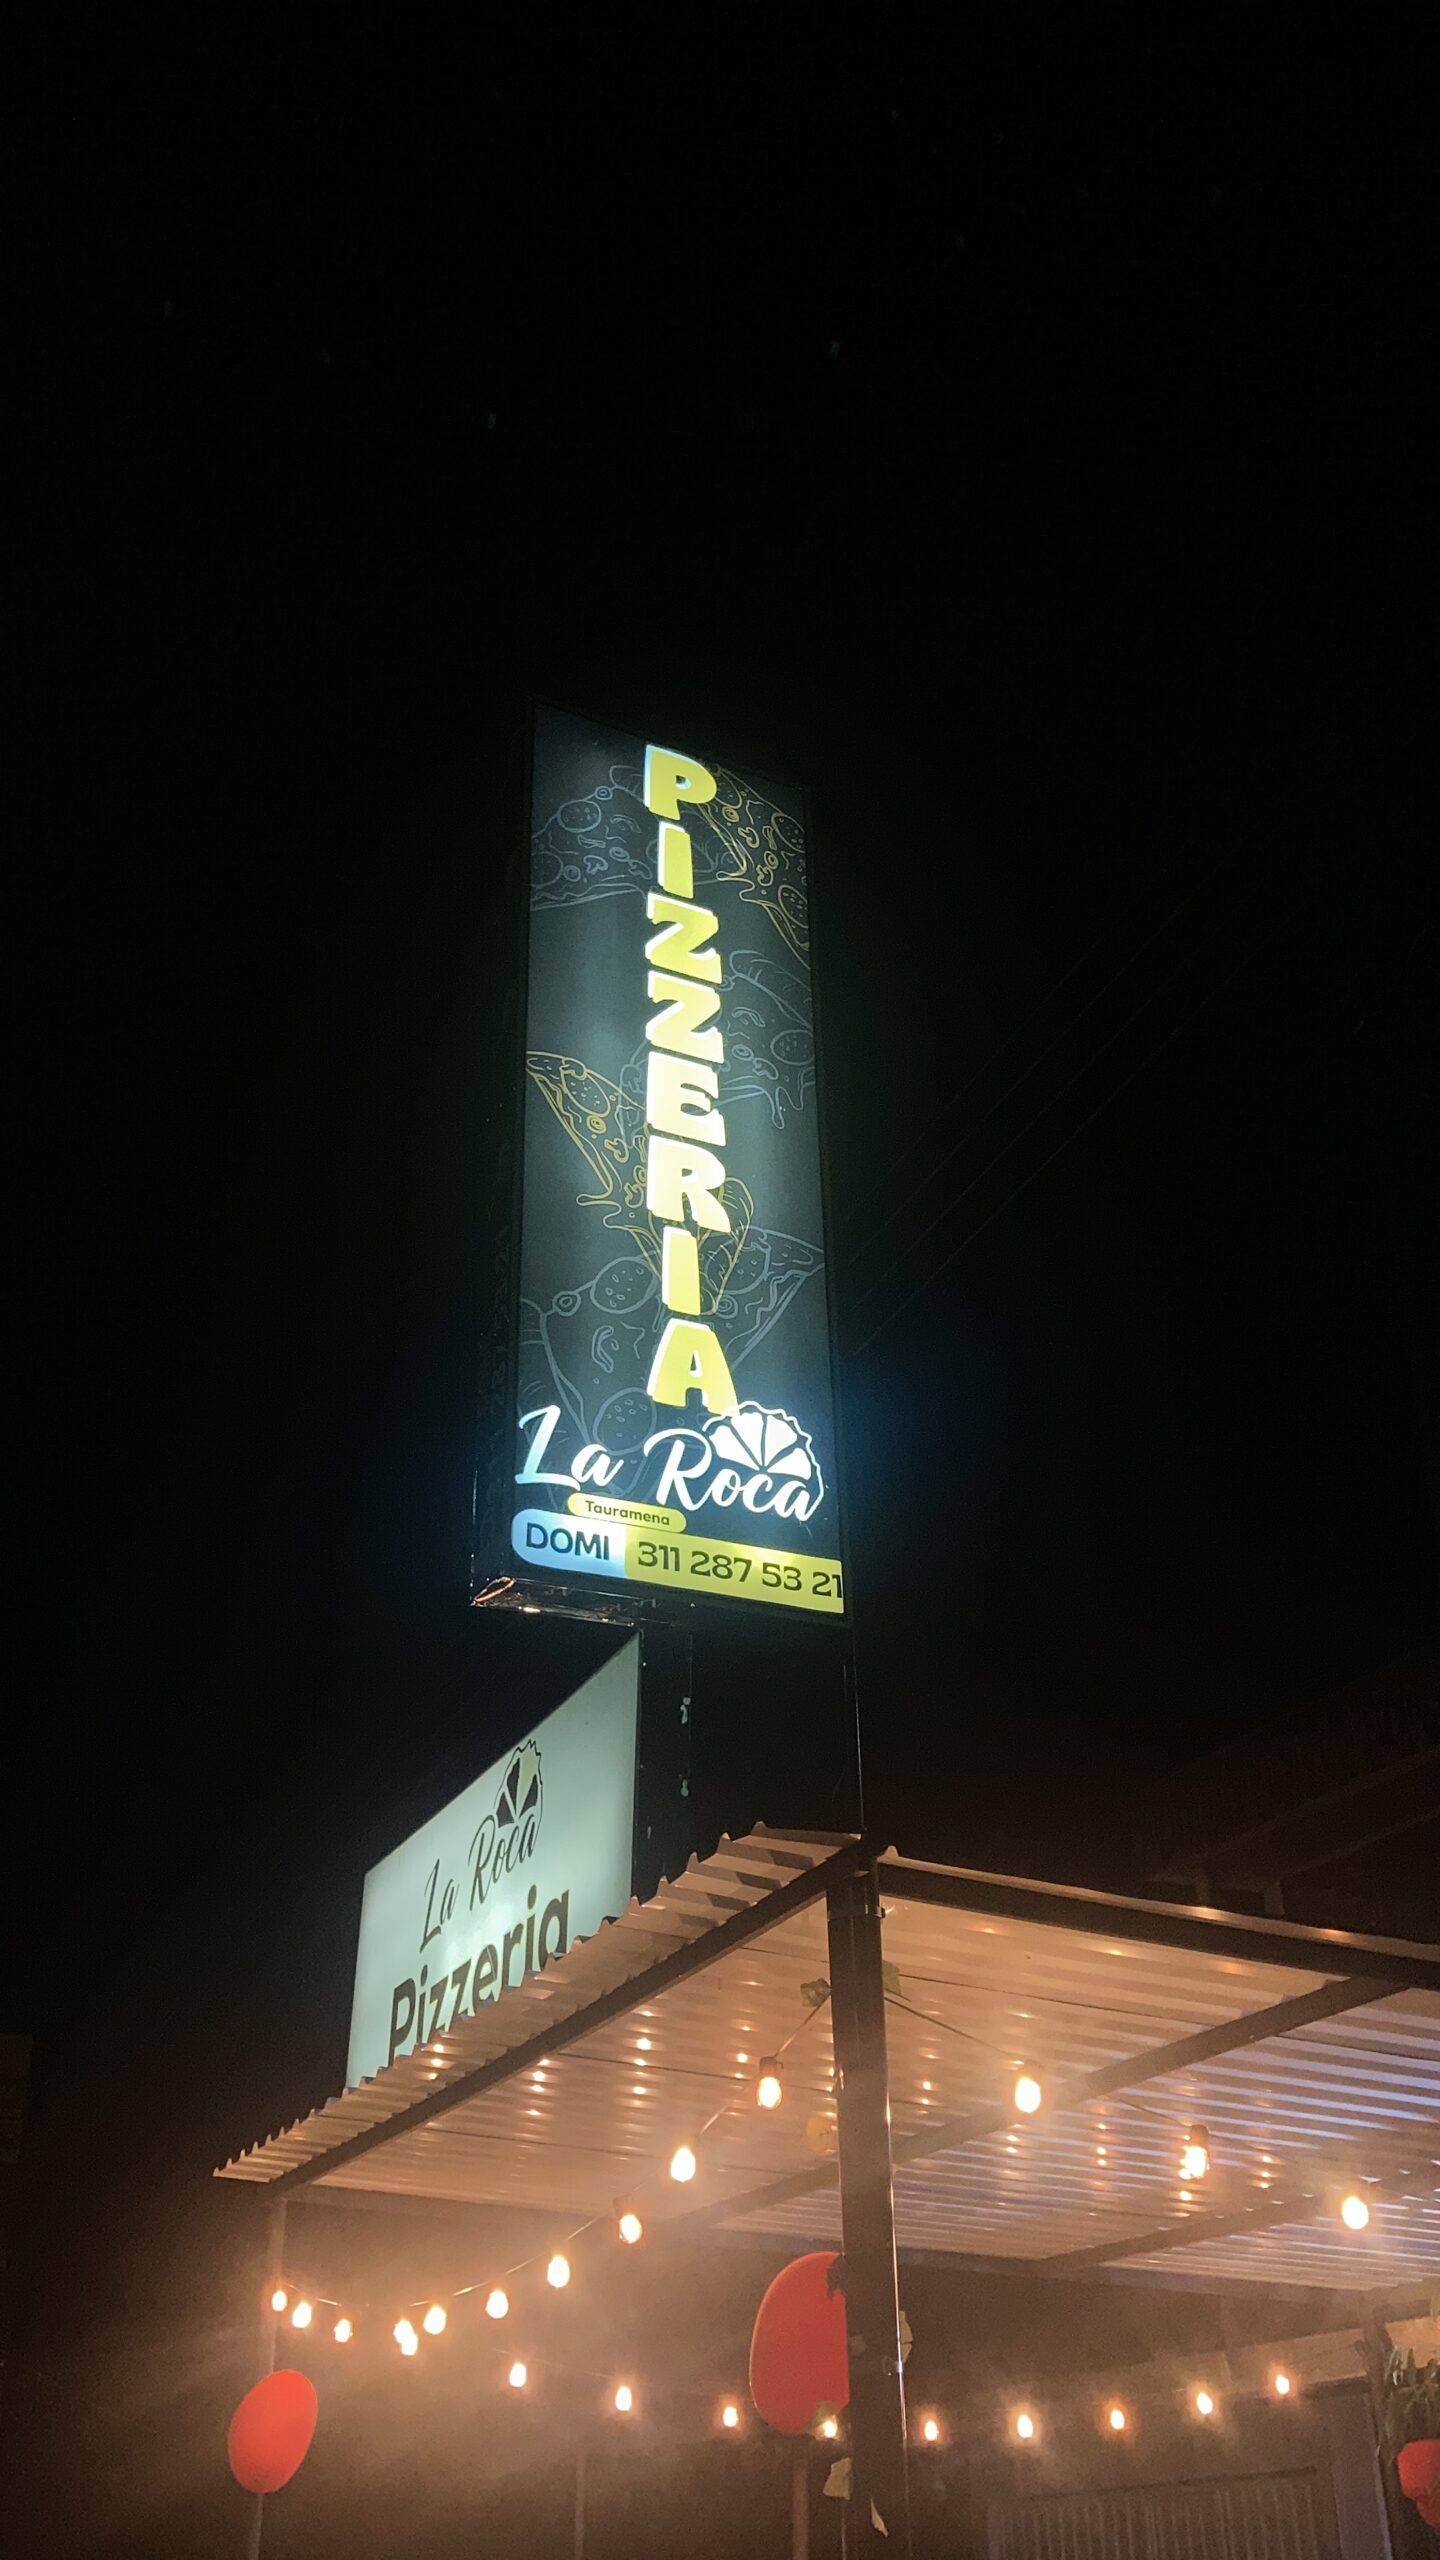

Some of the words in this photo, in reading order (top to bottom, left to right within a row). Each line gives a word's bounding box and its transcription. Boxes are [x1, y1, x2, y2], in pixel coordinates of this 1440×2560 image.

[644, 744, 741, 1418] PIZZERIA
[515, 1404, 624, 1491] La
[644, 1428, 821, 1521] Roca
[585, 1500, 671, 1526] Tauramena
[525, 1522, 610, 1561] DOMI
[637, 1541, 680, 1572] 311
[690, 1550, 752, 1583] 287
[761, 1562, 802, 1591] 53
[811, 1571, 843, 1599] 21
[419, 1858, 459, 1954] La
[468, 1814, 539, 1911] Roca
[388, 1884, 570, 2066] Pizzeria
